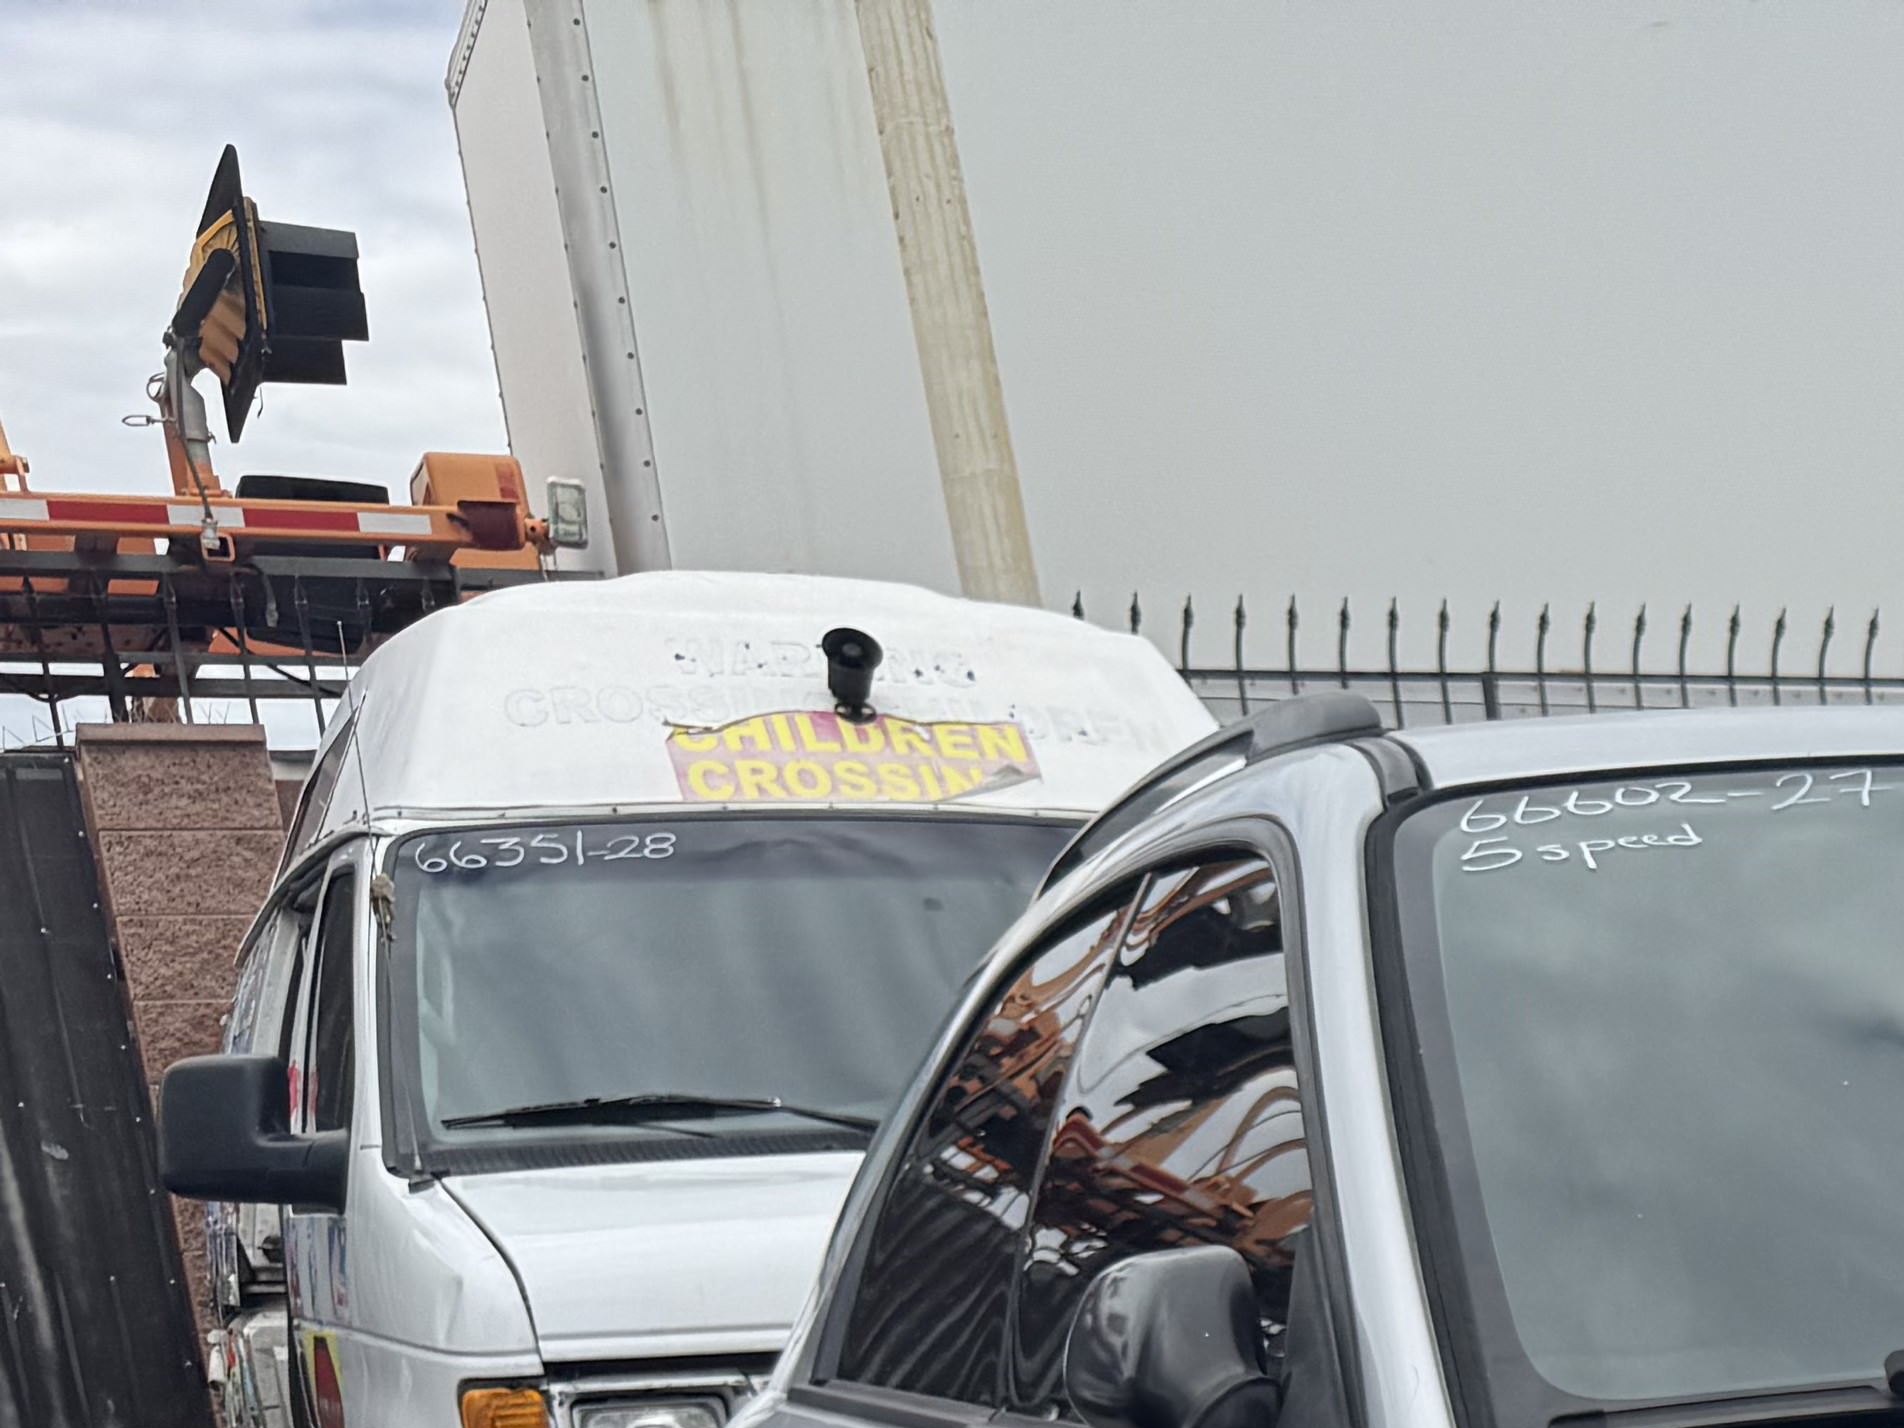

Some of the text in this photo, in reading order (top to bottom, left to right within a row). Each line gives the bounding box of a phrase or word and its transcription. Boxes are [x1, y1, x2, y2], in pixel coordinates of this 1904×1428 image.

[686, 758, 985, 801] CROSSIN
[1459, 767, 1895, 833] 66602-27
[414, 829, 677, 873] 66351-28
